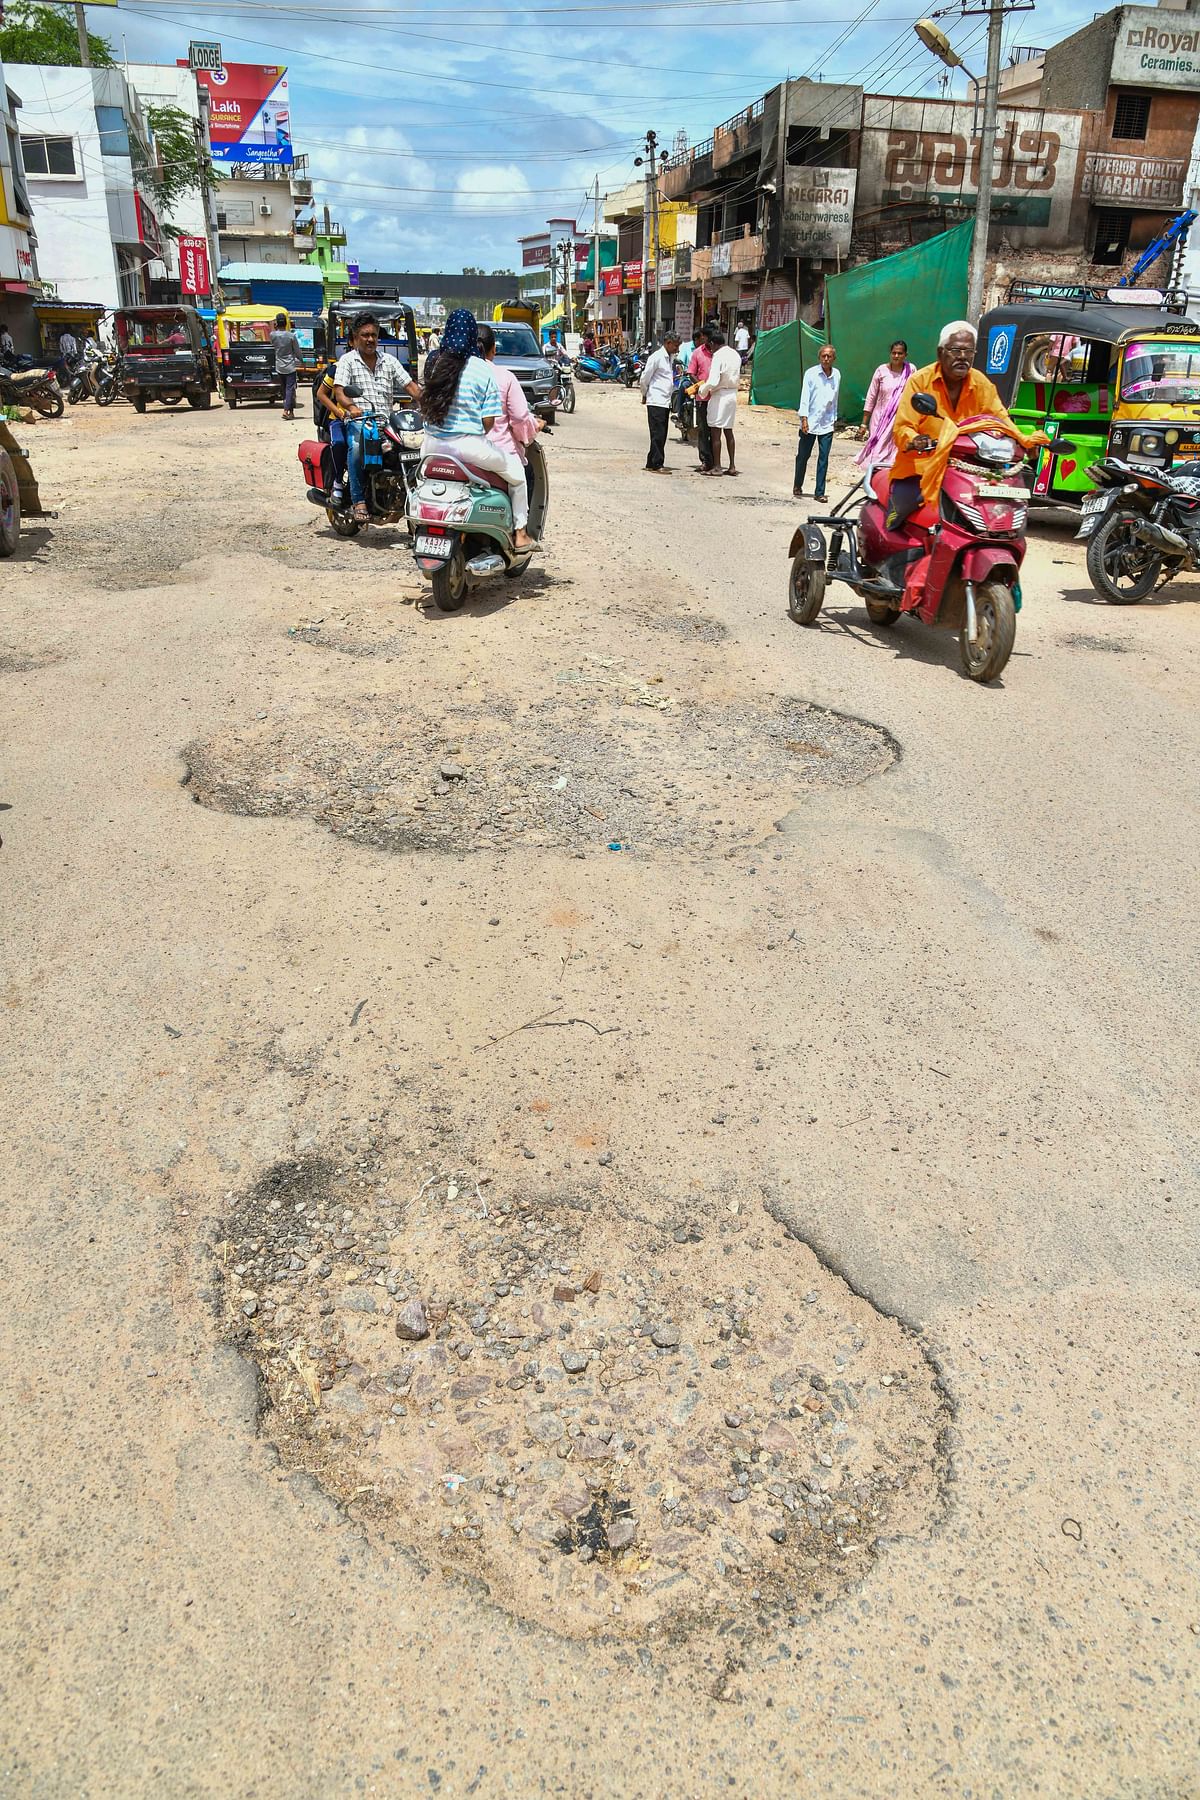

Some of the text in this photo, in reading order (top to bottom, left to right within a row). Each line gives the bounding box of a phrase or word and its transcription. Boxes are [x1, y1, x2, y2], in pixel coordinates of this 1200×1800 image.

[1143, 26, 1200, 54] Royal
[192, 47, 221, 68] LODGE
[212, 100, 241, 113] Lakh
[245, 147, 278, 161] Sangeetha
[885, 120, 1061, 199] ಭಾರತಿ
[1084, 157, 1183, 178] SUPERIOR QUALITY
[788, 187, 849, 206] MEGARAJ
[1081, 174, 1181, 199] GUARANTEED
[184, 249, 197, 293] Bata
[431, 466, 455, 475] SUZUKI
